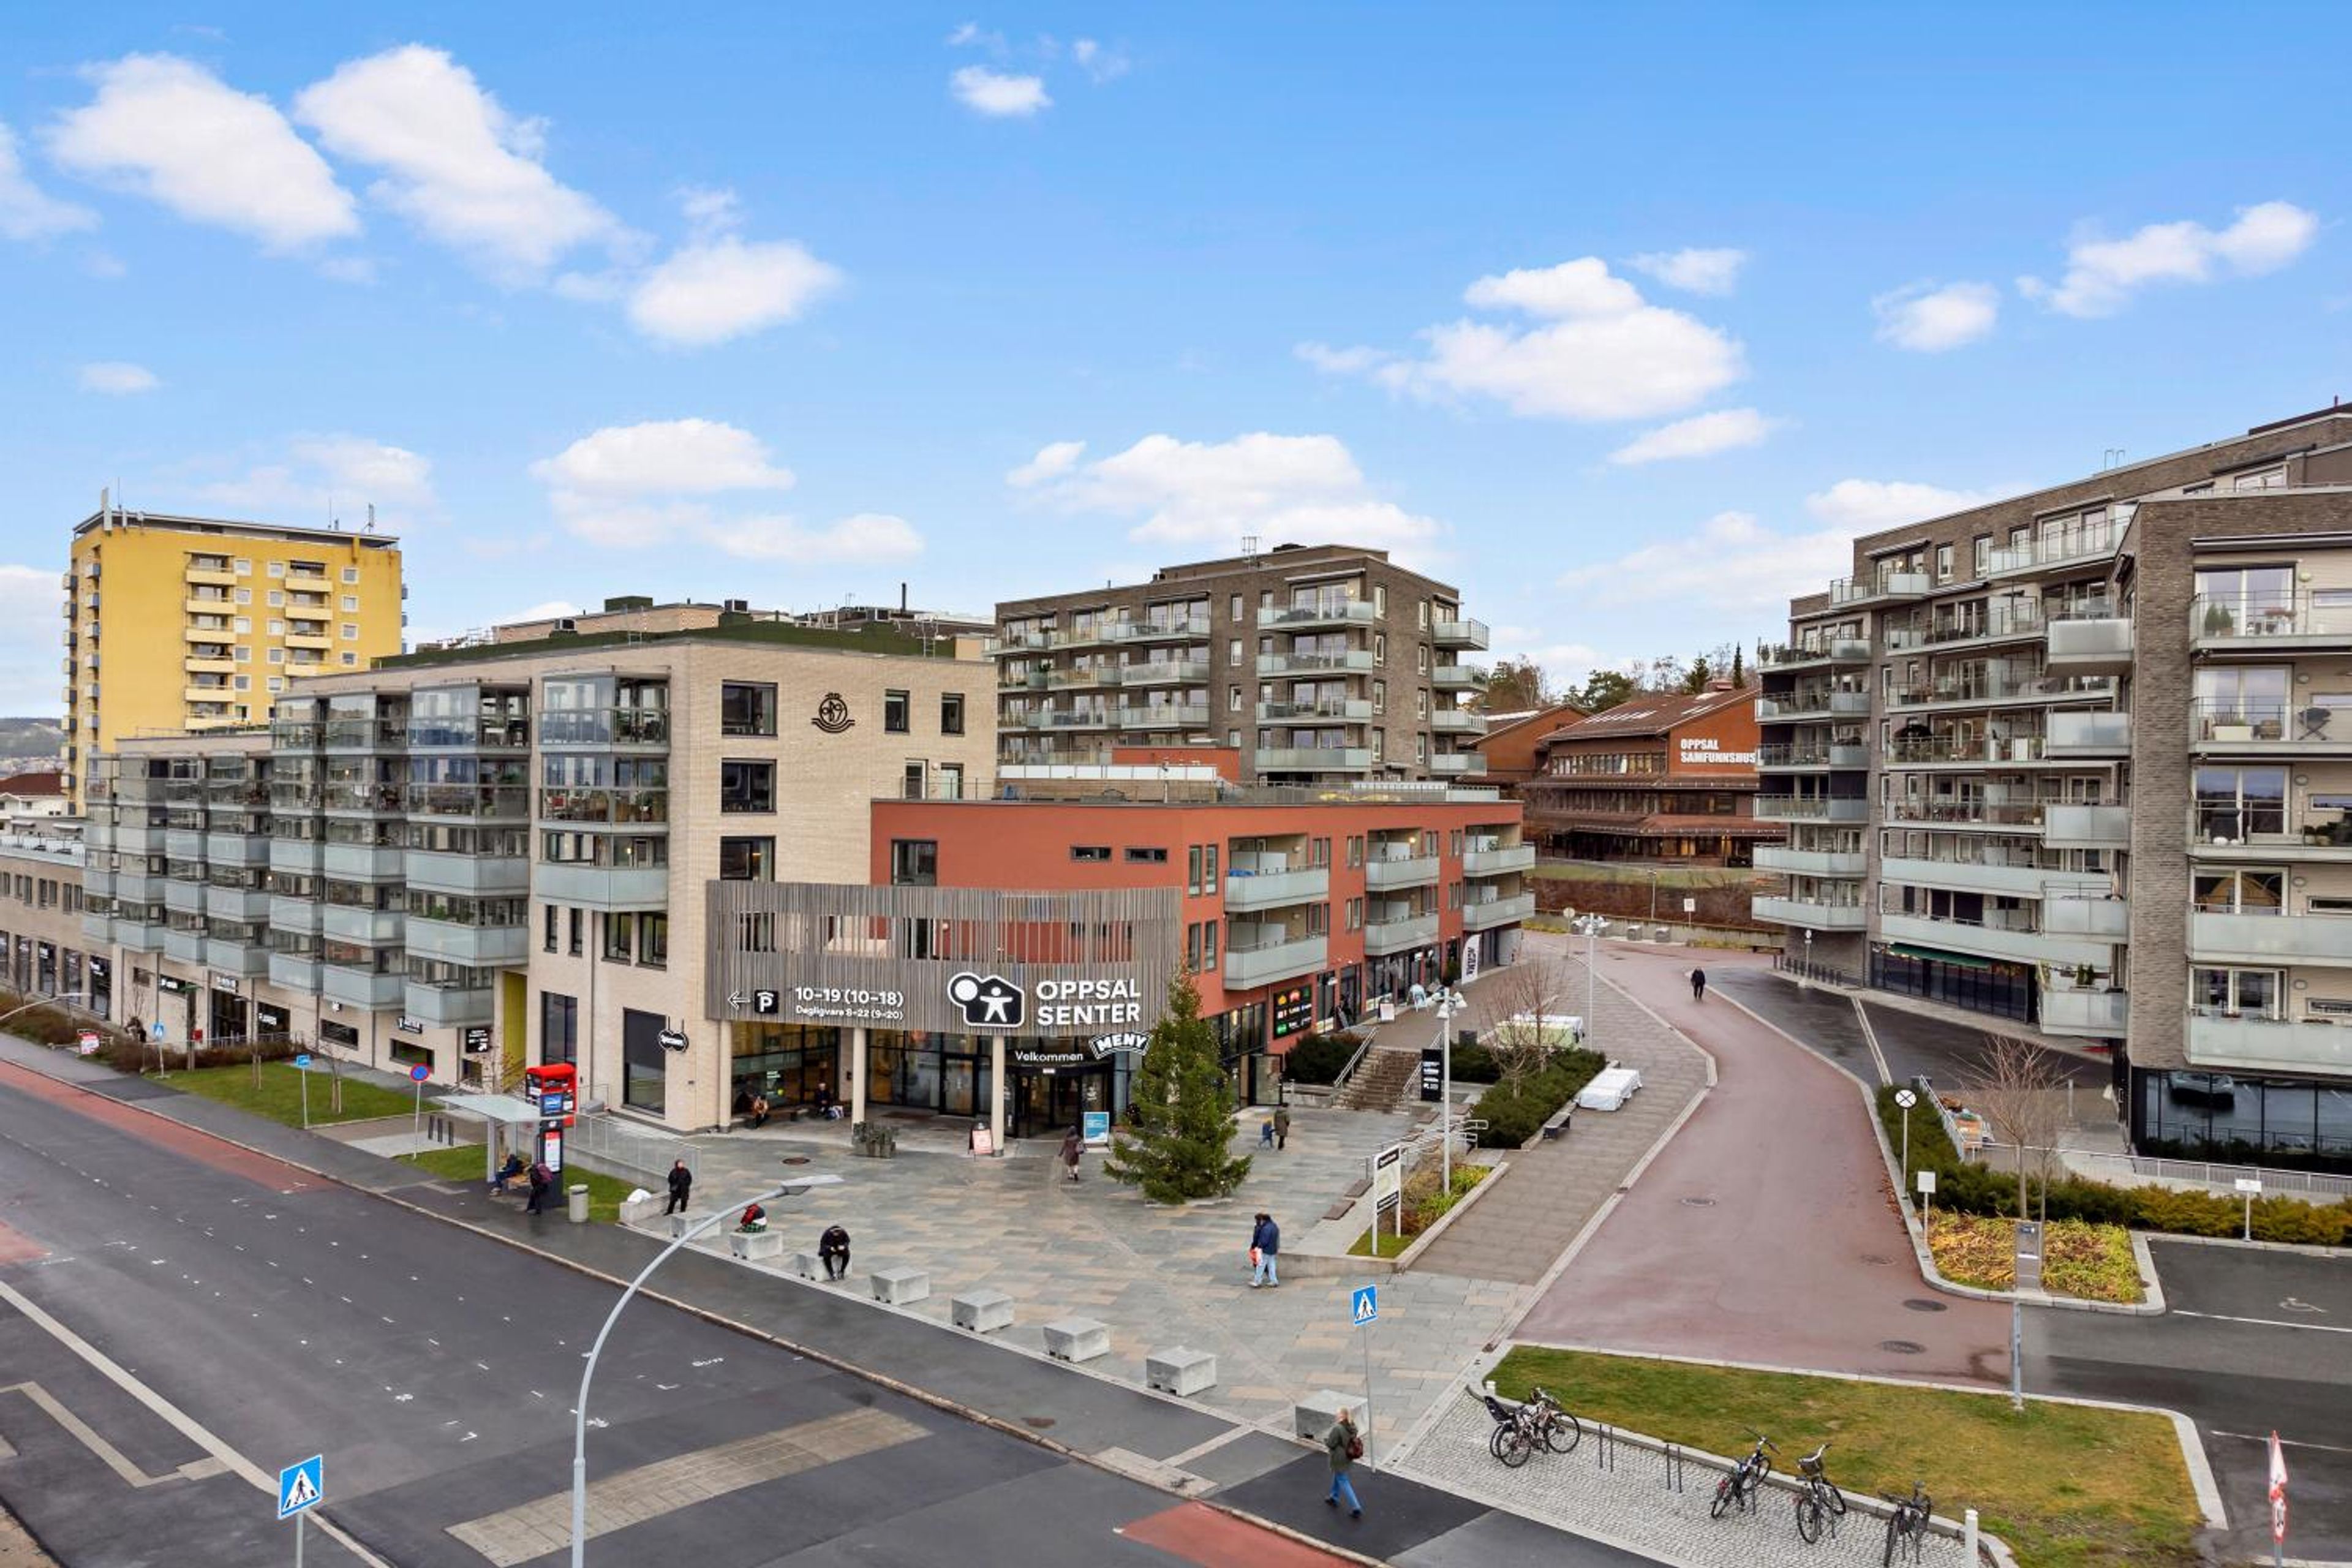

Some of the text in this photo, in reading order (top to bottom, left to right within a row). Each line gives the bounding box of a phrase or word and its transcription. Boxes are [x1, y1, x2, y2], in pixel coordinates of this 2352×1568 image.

[1681, 738, 1719, 750] OPPSAL
[1036, 979, 1141, 1000] OPPSAL
[796, 1005, 845, 1017] Dagligvare
[1036, 1003, 1140, 1025] SENTER
[1096, 1033, 1148, 1052] MENY
[1015, 1050, 1084, 1062] Velkommen
